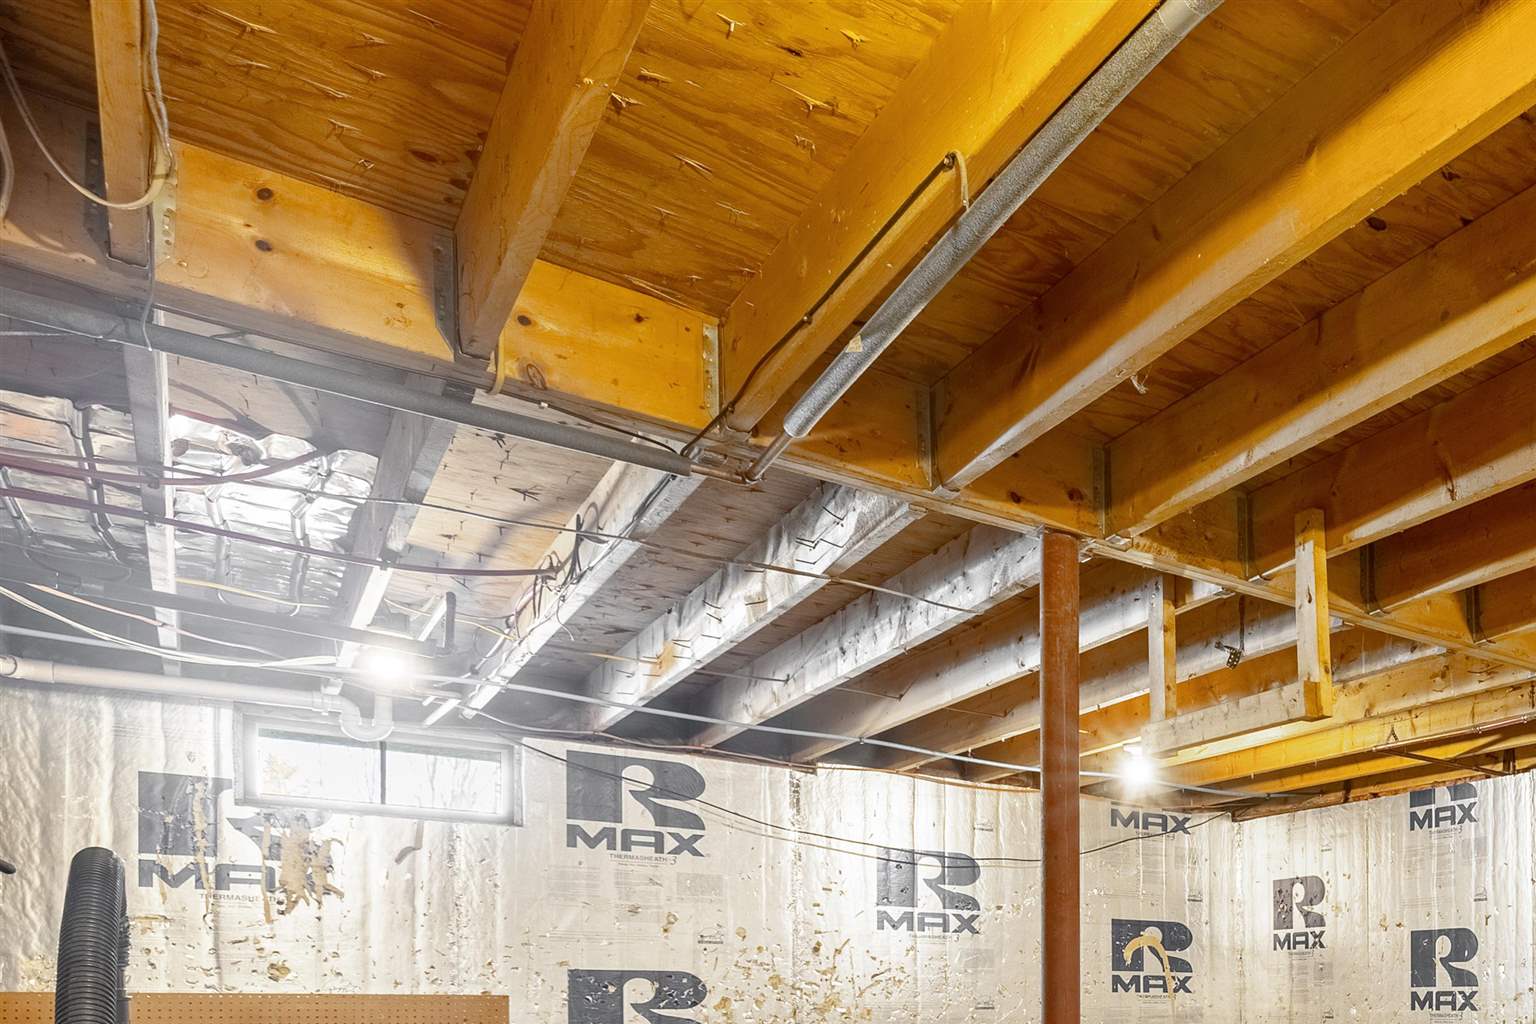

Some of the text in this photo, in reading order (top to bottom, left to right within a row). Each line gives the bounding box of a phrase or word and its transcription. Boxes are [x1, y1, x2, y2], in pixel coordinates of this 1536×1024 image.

[566, 750, 706, 830] R
[1111, 808, 1191, 835] MAX
[1410, 802, 1478, 831] MAX
[566, 824, 705, 857] MAX
[877, 849, 981, 911] R
[1273, 876, 1326, 930] R
[877, 910, 981, 934] MAX
[1273, 930, 1326, 951] MAX
[1411, 928, 1478, 987] R
[1112, 975, 1193, 993] MAX
[1411, 991, 1478, 1011] MAX
